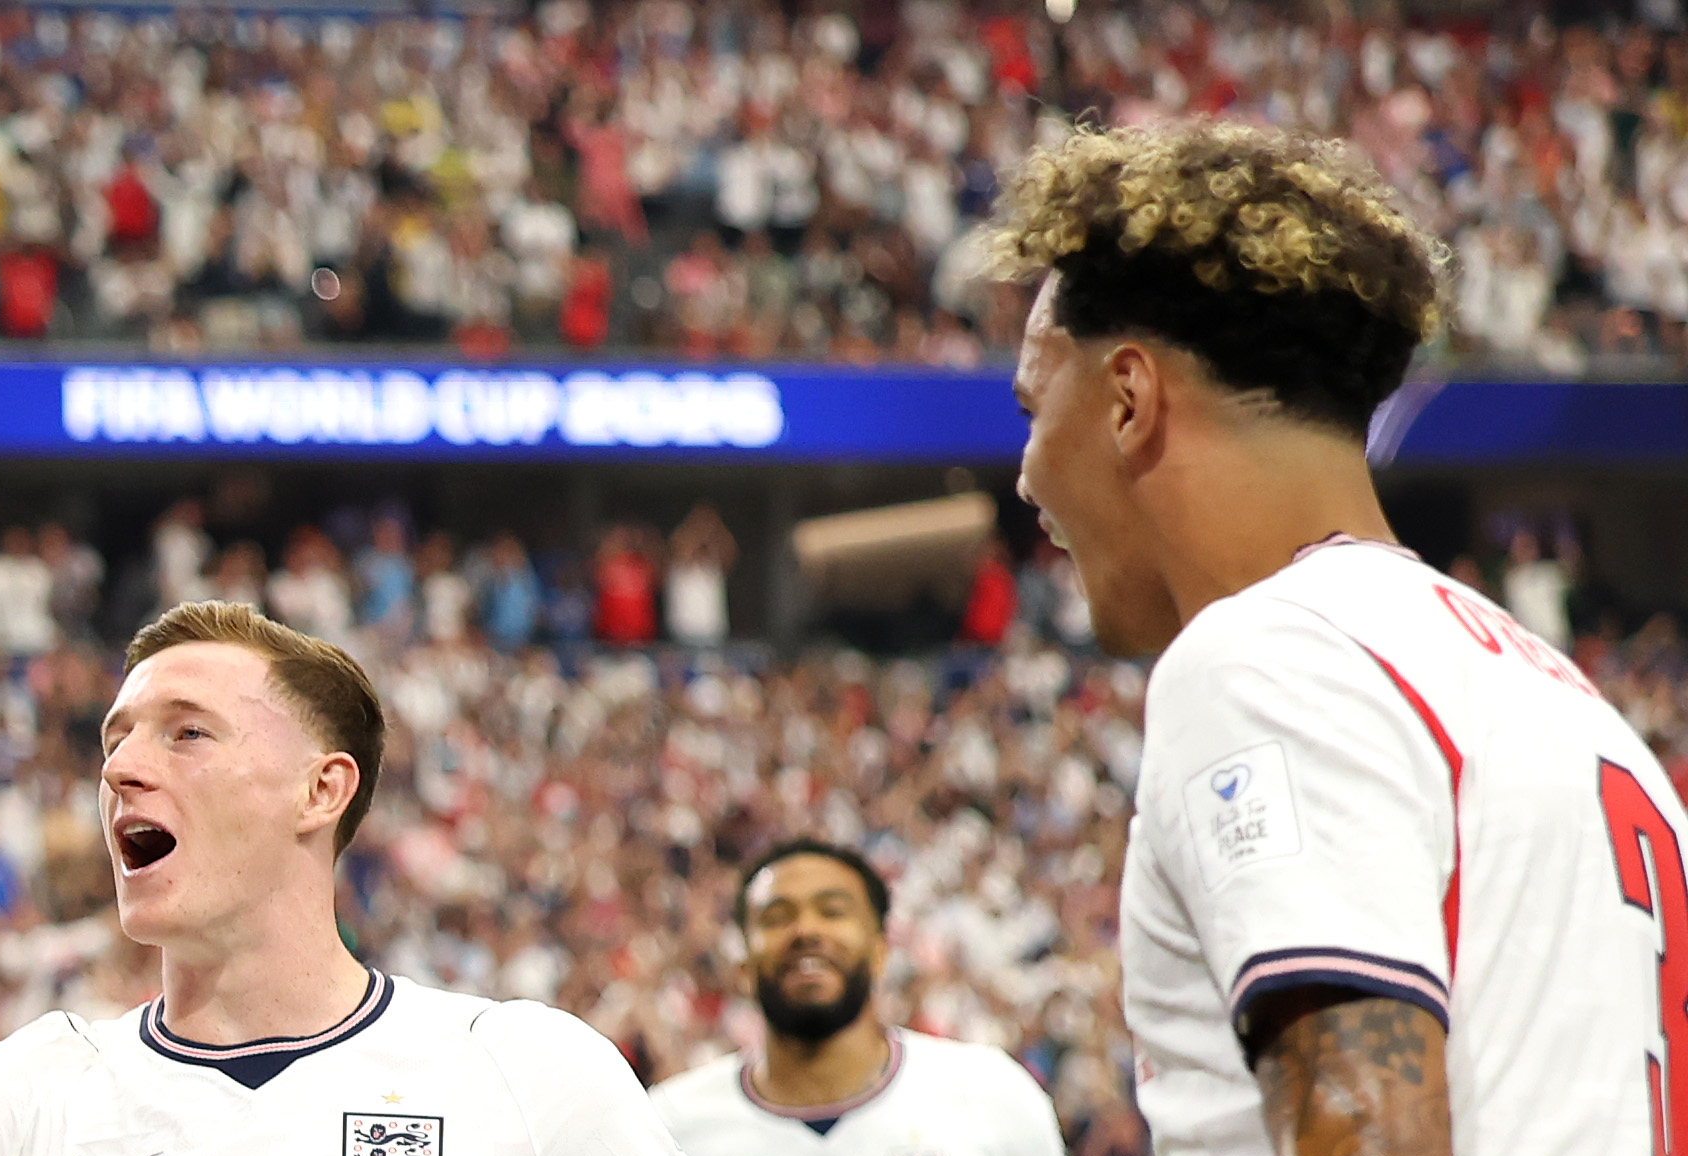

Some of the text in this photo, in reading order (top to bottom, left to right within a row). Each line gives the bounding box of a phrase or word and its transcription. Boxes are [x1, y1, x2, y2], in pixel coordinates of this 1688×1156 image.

[63, 368, 784, 448] FIFA WORLD CUP 2026
